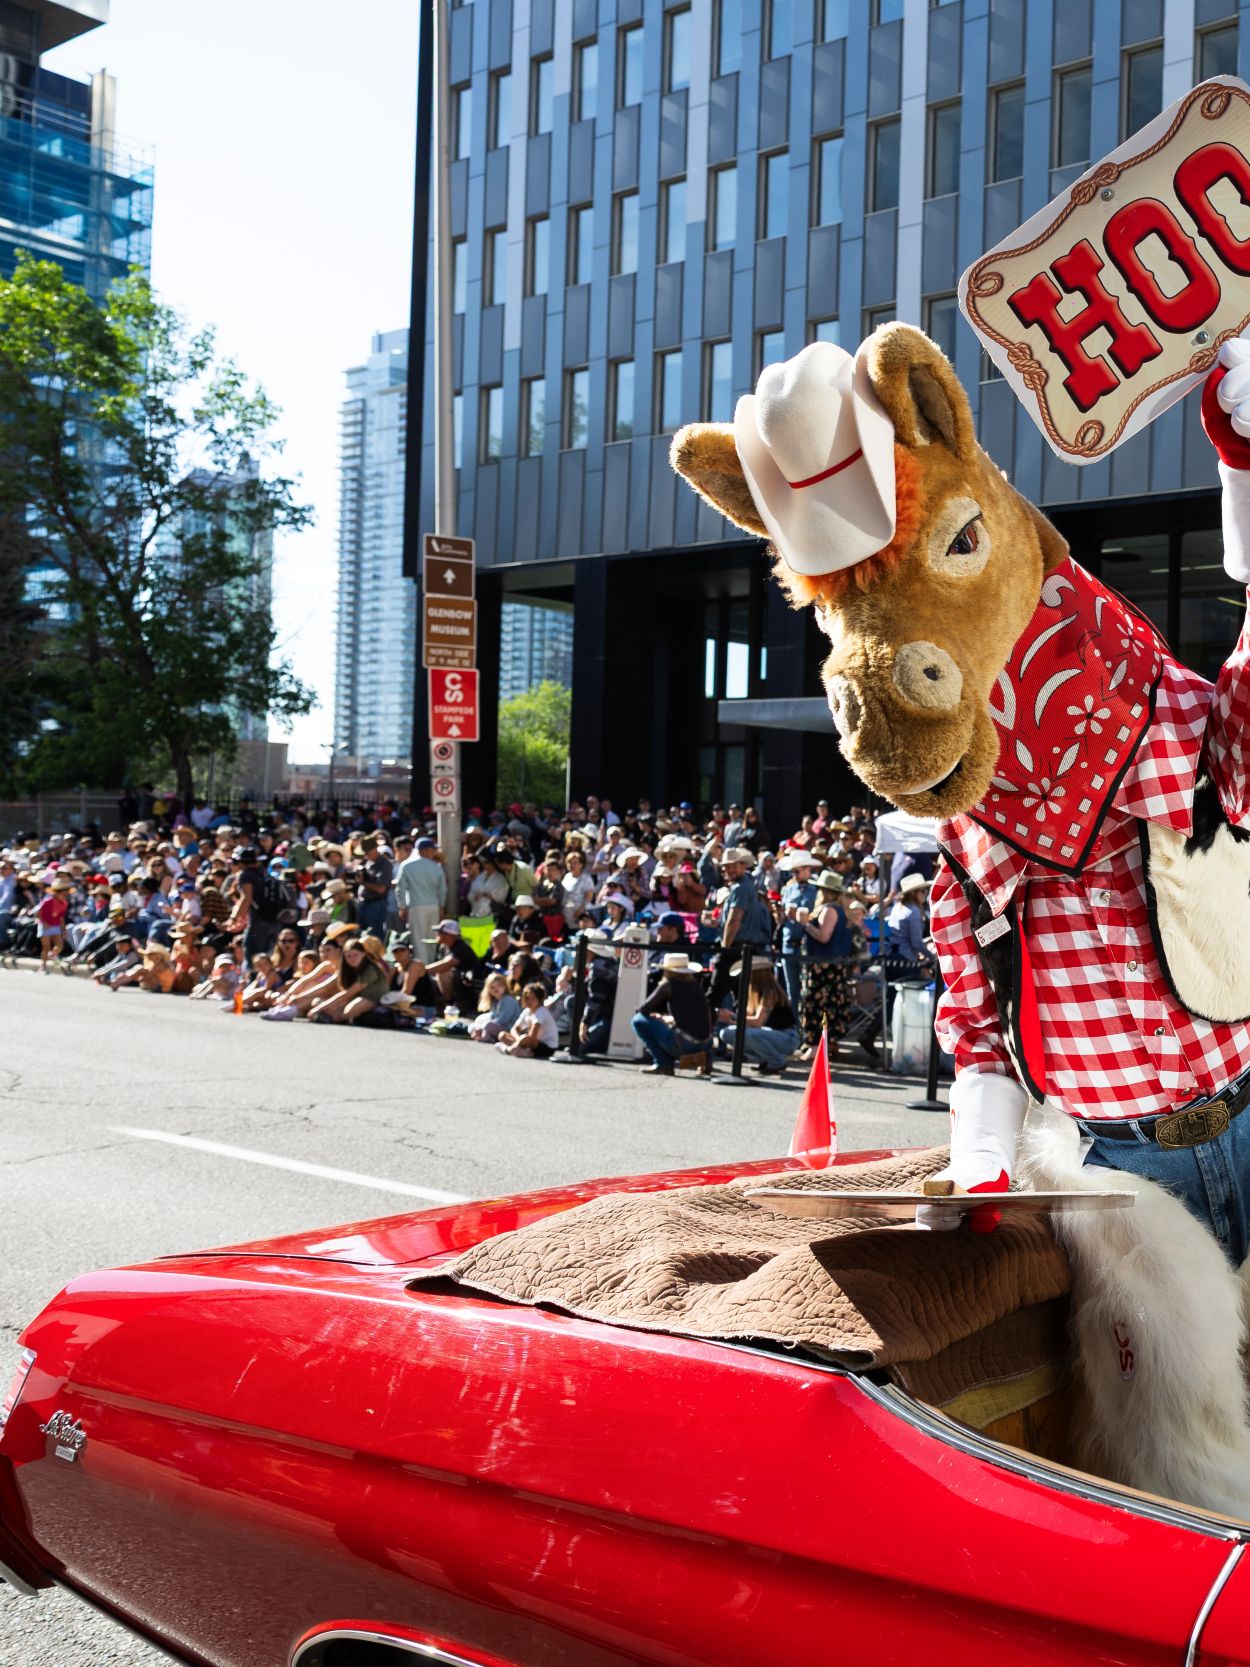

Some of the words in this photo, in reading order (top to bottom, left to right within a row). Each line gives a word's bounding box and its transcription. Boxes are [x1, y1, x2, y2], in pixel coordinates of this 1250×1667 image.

[428, 608, 472, 620] GLENBOW
[430, 624, 470, 636] MUSEUM
[434, 705, 474, 715] STAMPEDE
[443, 715, 464, 724] PARK
